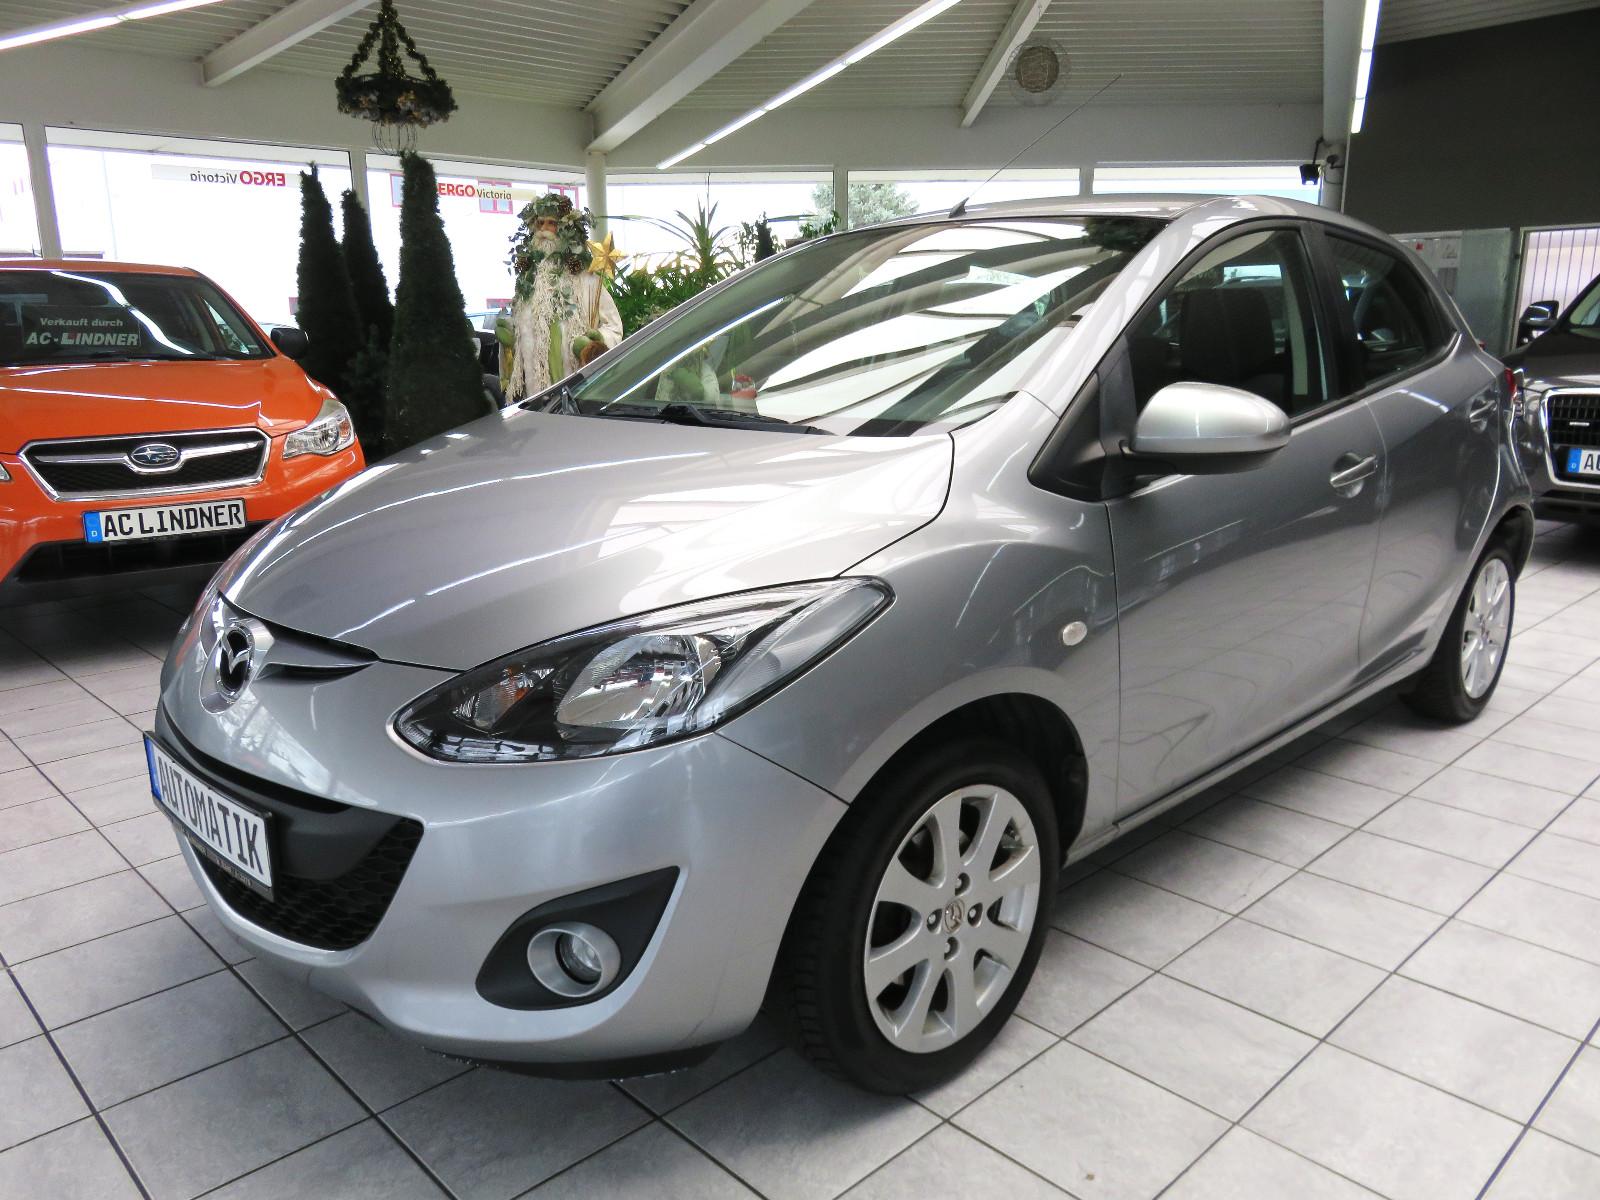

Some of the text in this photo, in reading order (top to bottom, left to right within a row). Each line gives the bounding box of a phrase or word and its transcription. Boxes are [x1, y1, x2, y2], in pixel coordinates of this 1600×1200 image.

[437, 183, 512, 200] ERGO Victoria
[40, 318, 123, 327] Verkauft durch
[104, 503, 243, 537] AC LINDNER
[158, 755, 264, 876] AUTOMATIK
